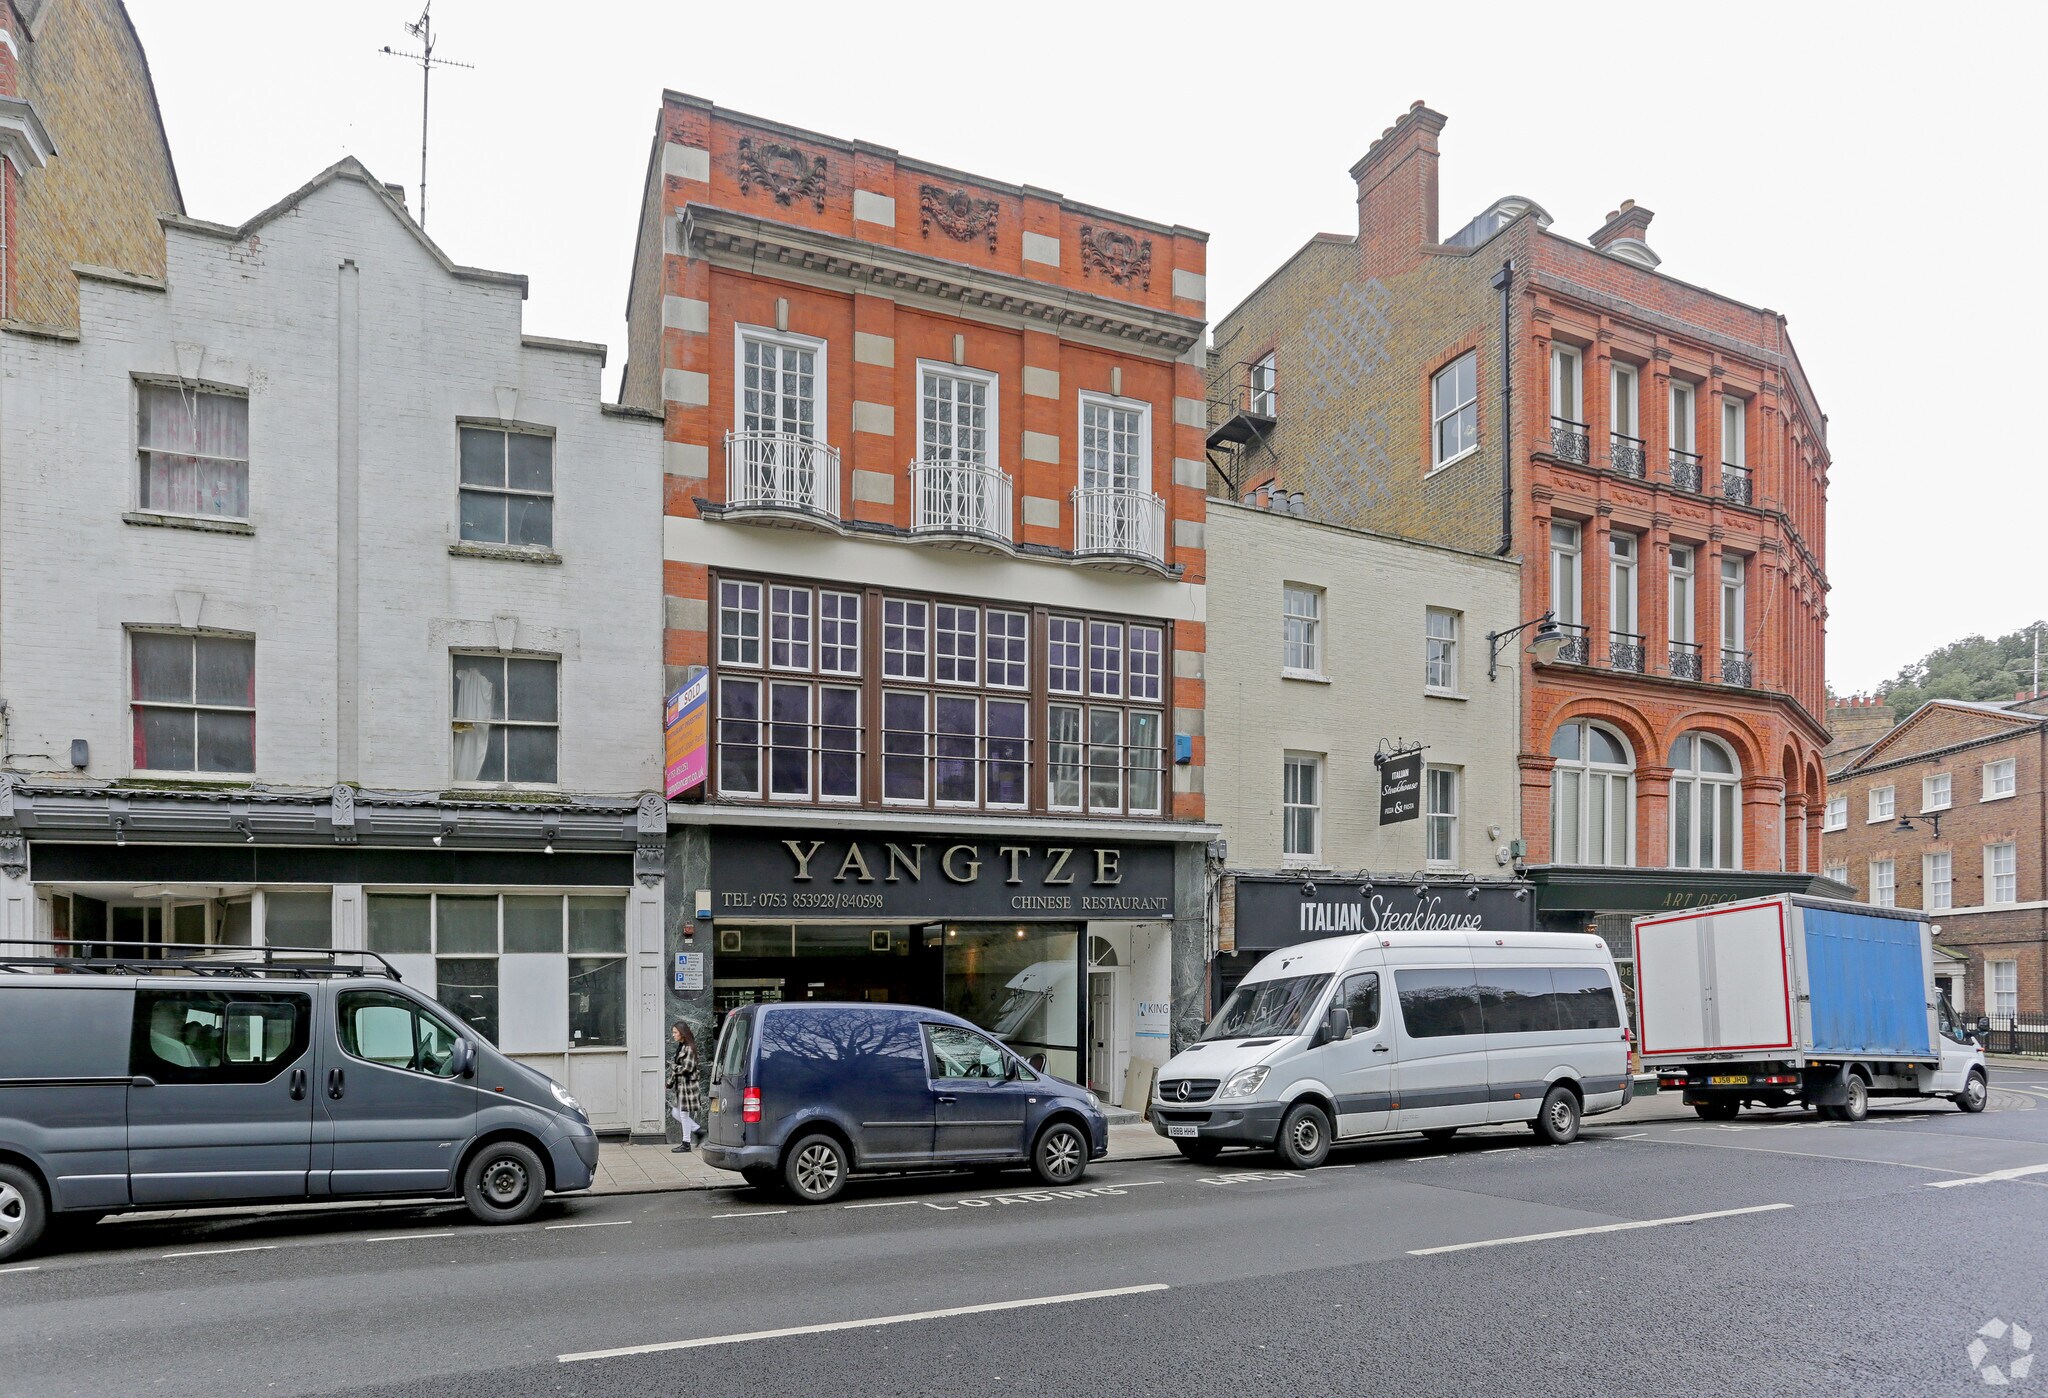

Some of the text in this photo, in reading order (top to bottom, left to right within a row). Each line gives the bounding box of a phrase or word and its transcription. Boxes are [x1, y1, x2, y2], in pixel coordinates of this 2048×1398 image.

[684, 682, 701, 706] SOLD
[1391, 768, 1409, 780] ITALIAN
[1382, 780, 1418, 796] Steakhouse
[1394, 801, 1403, 814] &
[781, 839, 1123, 885] YANGTZE
[721, 892, 884, 909] TEL: 0753 853928/840598
[1011, 895, 1168, 910] CHINESE RESTAURANT
[1661, 892, 1693, 907] ART
[1300, 894, 1482, 933] ITALIAN Steakhouse
[1148, 1003, 1169, 1014] KING
[923, 1187, 1128, 1211] LOADING
